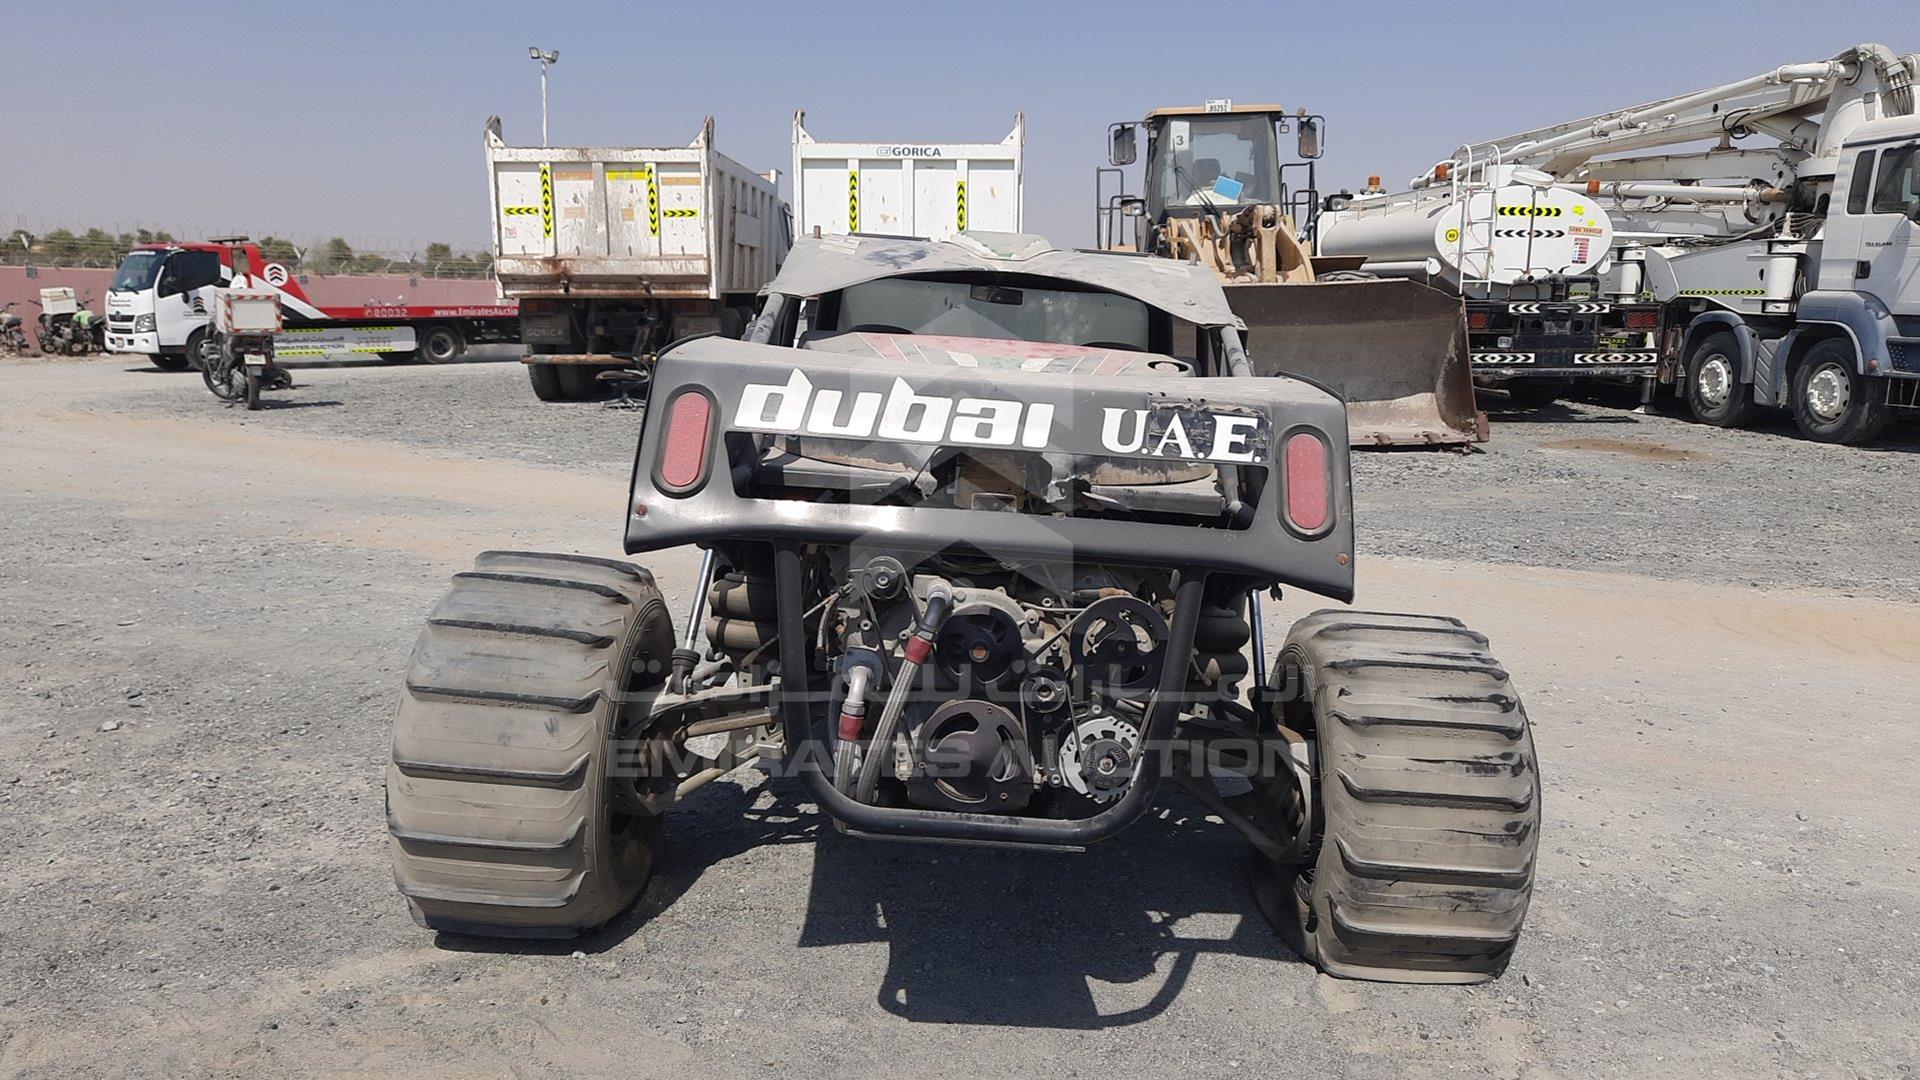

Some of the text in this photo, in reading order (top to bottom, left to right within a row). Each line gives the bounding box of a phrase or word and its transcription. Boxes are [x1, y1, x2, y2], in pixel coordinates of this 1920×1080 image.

[1175, 135, 1184, 146] 3
[892, 146, 942, 157] GORICA
[374, 307, 408, 318] 80032
[526, 328, 564, 337] GORICA
[734, 368, 1262, 464] dubai U.A.E.
